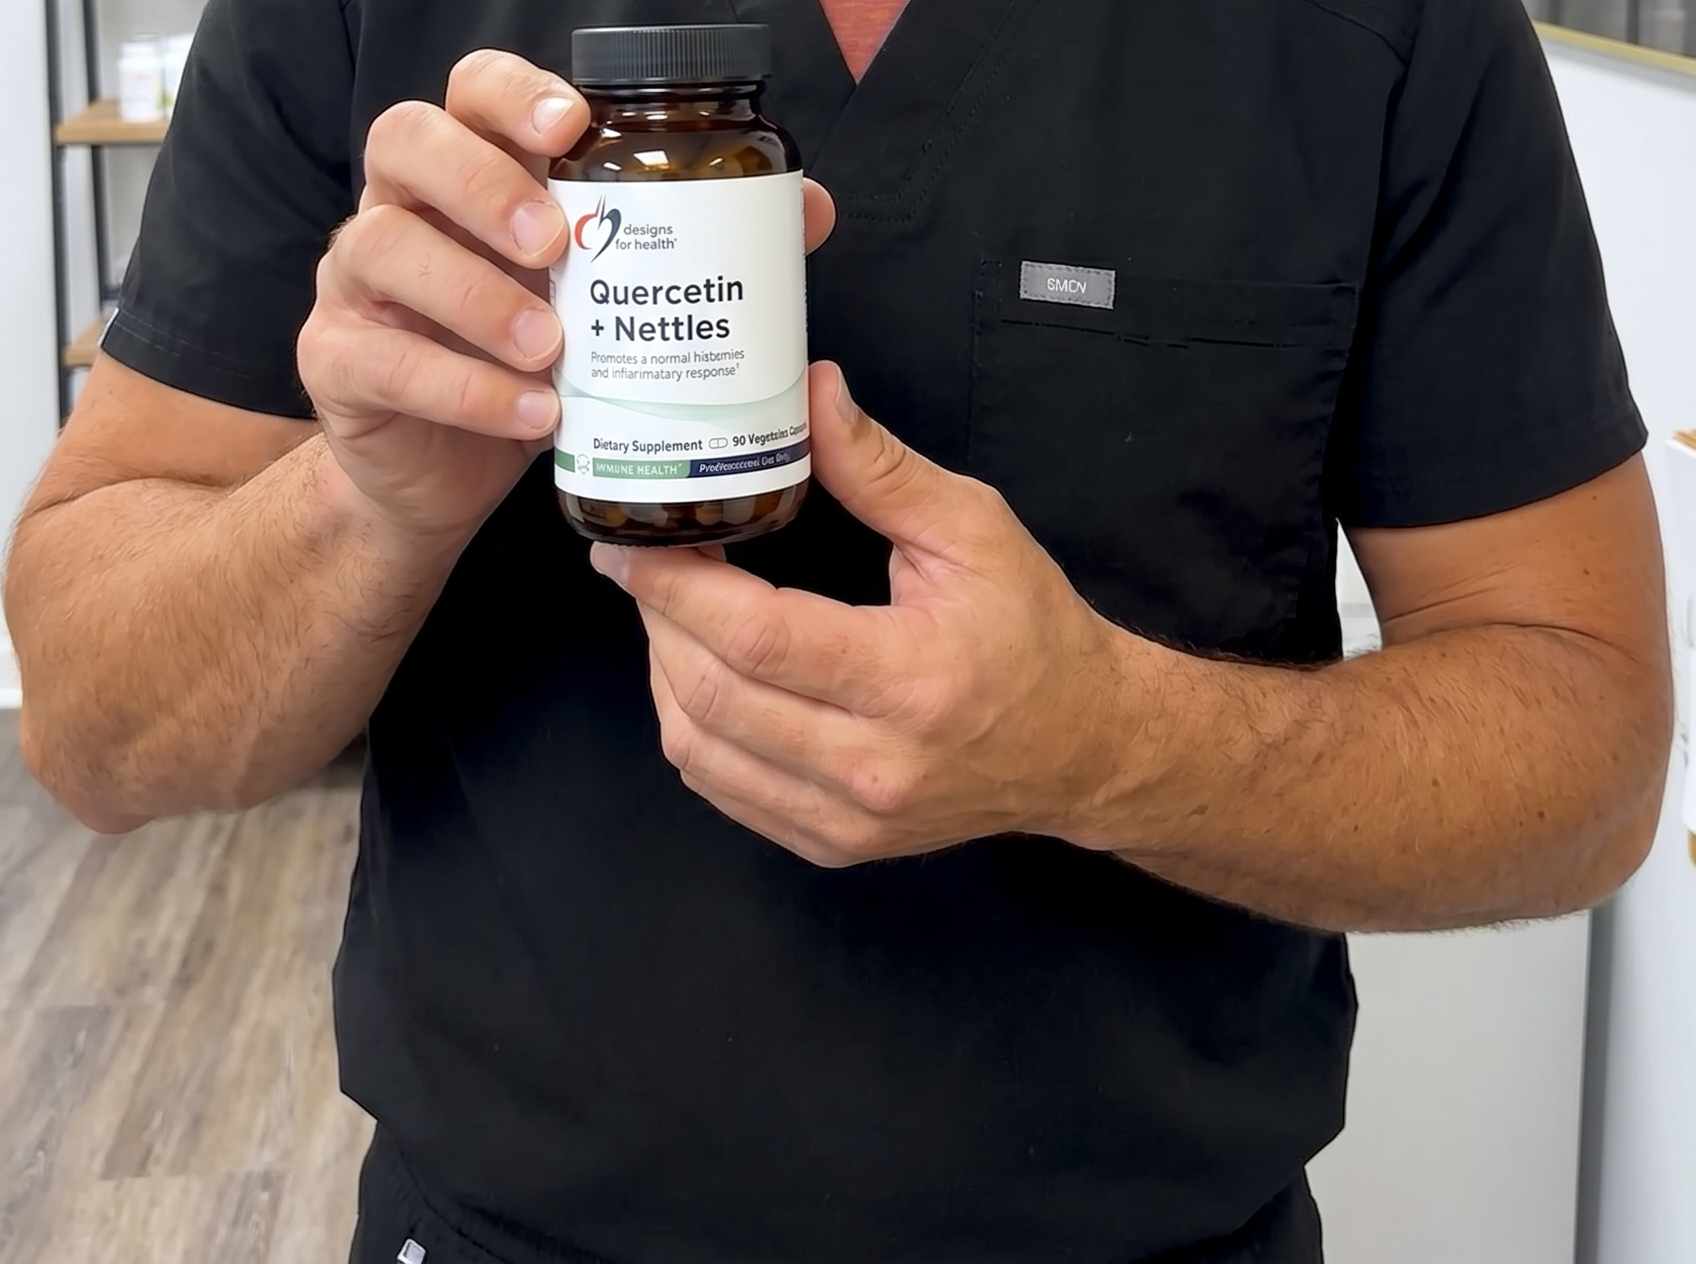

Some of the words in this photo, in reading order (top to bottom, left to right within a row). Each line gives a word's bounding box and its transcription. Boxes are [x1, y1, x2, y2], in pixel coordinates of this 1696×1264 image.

[623, 224, 673, 238] designs
[615, 238, 632, 250] for
[590, 275, 743, 305] Quercetin
[615, 314, 730, 342] Nettles
[591, 351, 638, 364] Promotes
[641, 355, 647, 365] a
[650, 352, 690, 365] normal
[591, 367, 609, 379] and
[593, 438, 630, 454] Dietary
[632, 439, 703, 455] Supplement
[732, 435, 746, 447] 90
